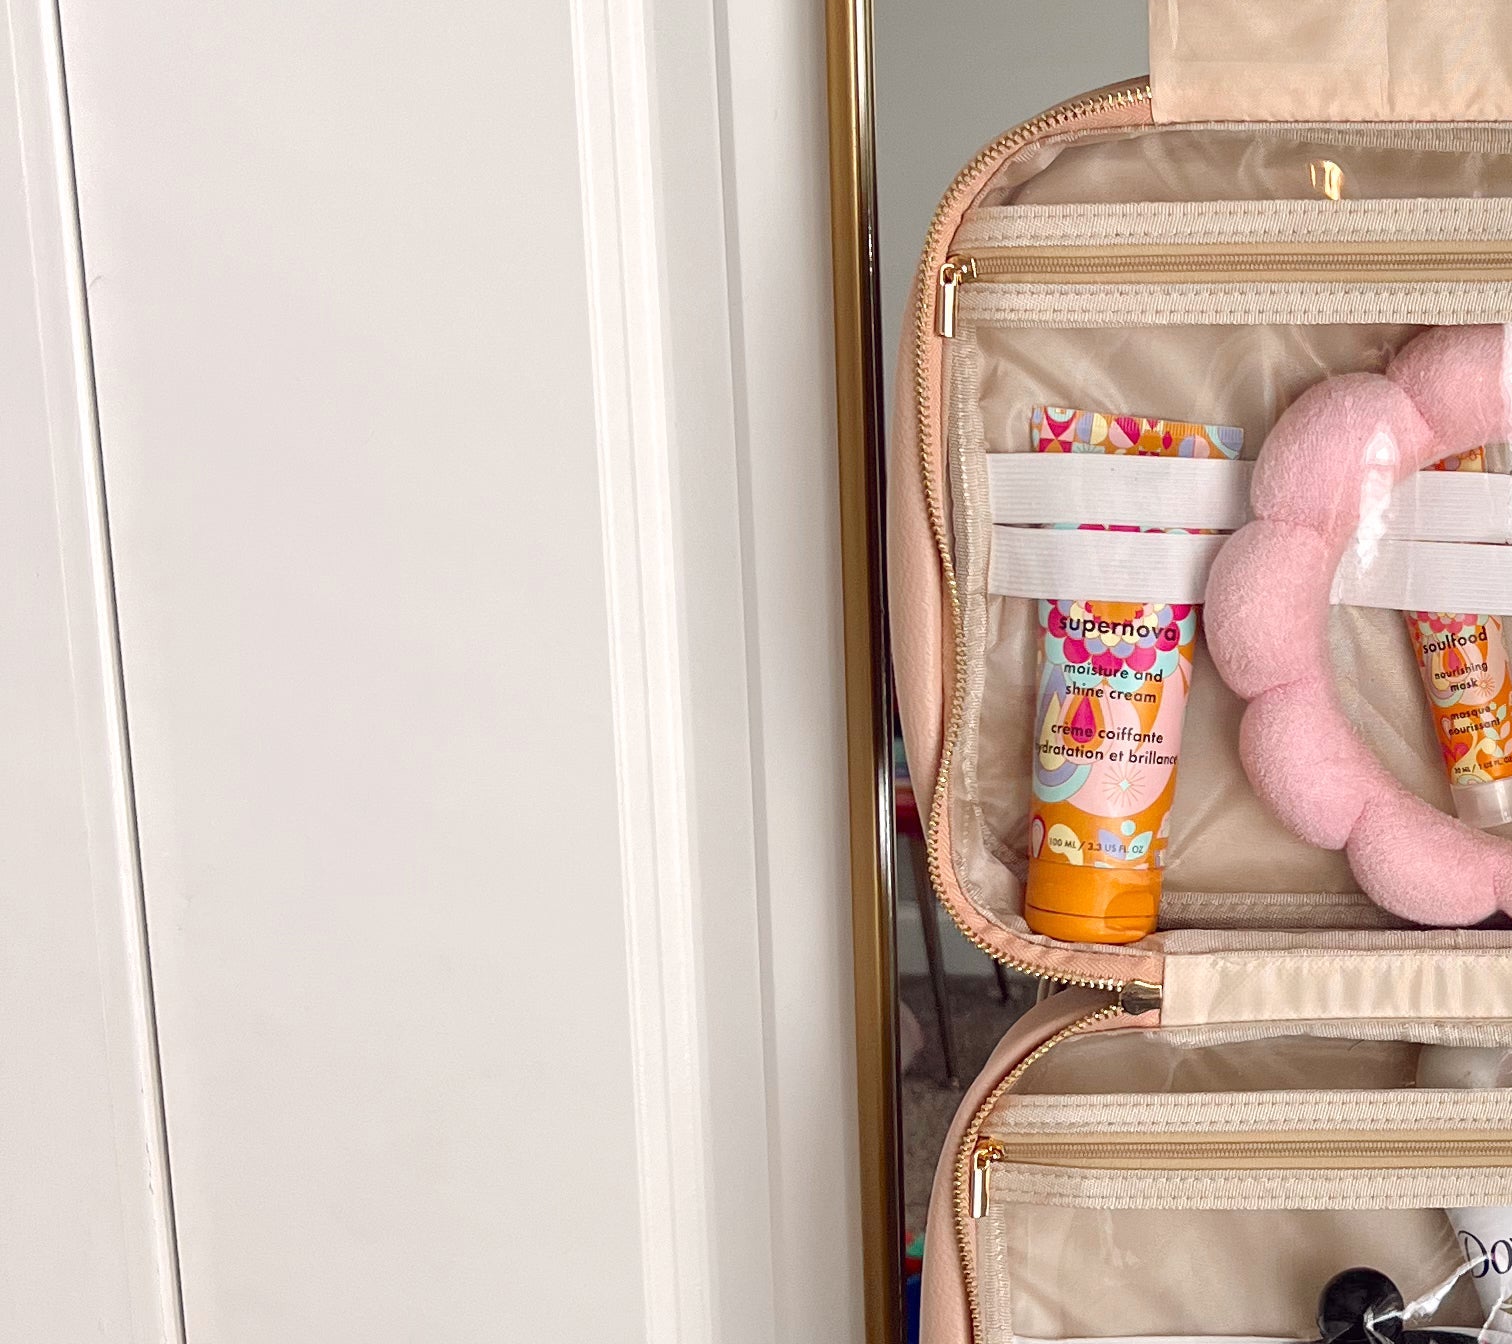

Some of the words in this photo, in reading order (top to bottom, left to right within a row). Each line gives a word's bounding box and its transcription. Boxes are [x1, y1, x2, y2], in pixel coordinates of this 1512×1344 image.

[1058, 616, 1177, 642] supernova
[1422, 625, 1488, 655] soulfood
[1063, 662, 1129, 679] moisture
[1133, 668, 1164, 683] and
[1434, 661, 1488, 680] nourishing
[1065, 682, 1105, 698] shine
[1109, 688, 1157, 704] cream
[1449, 678, 1479, 693] mask
[1450, 706, 1491, 722] masque
[1050, 719, 1094, 738] crème
[1097, 727, 1164, 744] coiffante
[1448, 717, 1501, 736] nourissant
[1109, 751, 1124, 762] et
[1049, 837, 1062, 847] 100
[1064, 839, 1076, 849] ML
[1087, 842, 1102, 852] 3.3
[1104, 843, 1117, 853] US
[1131, 845, 1144, 854] OZ
